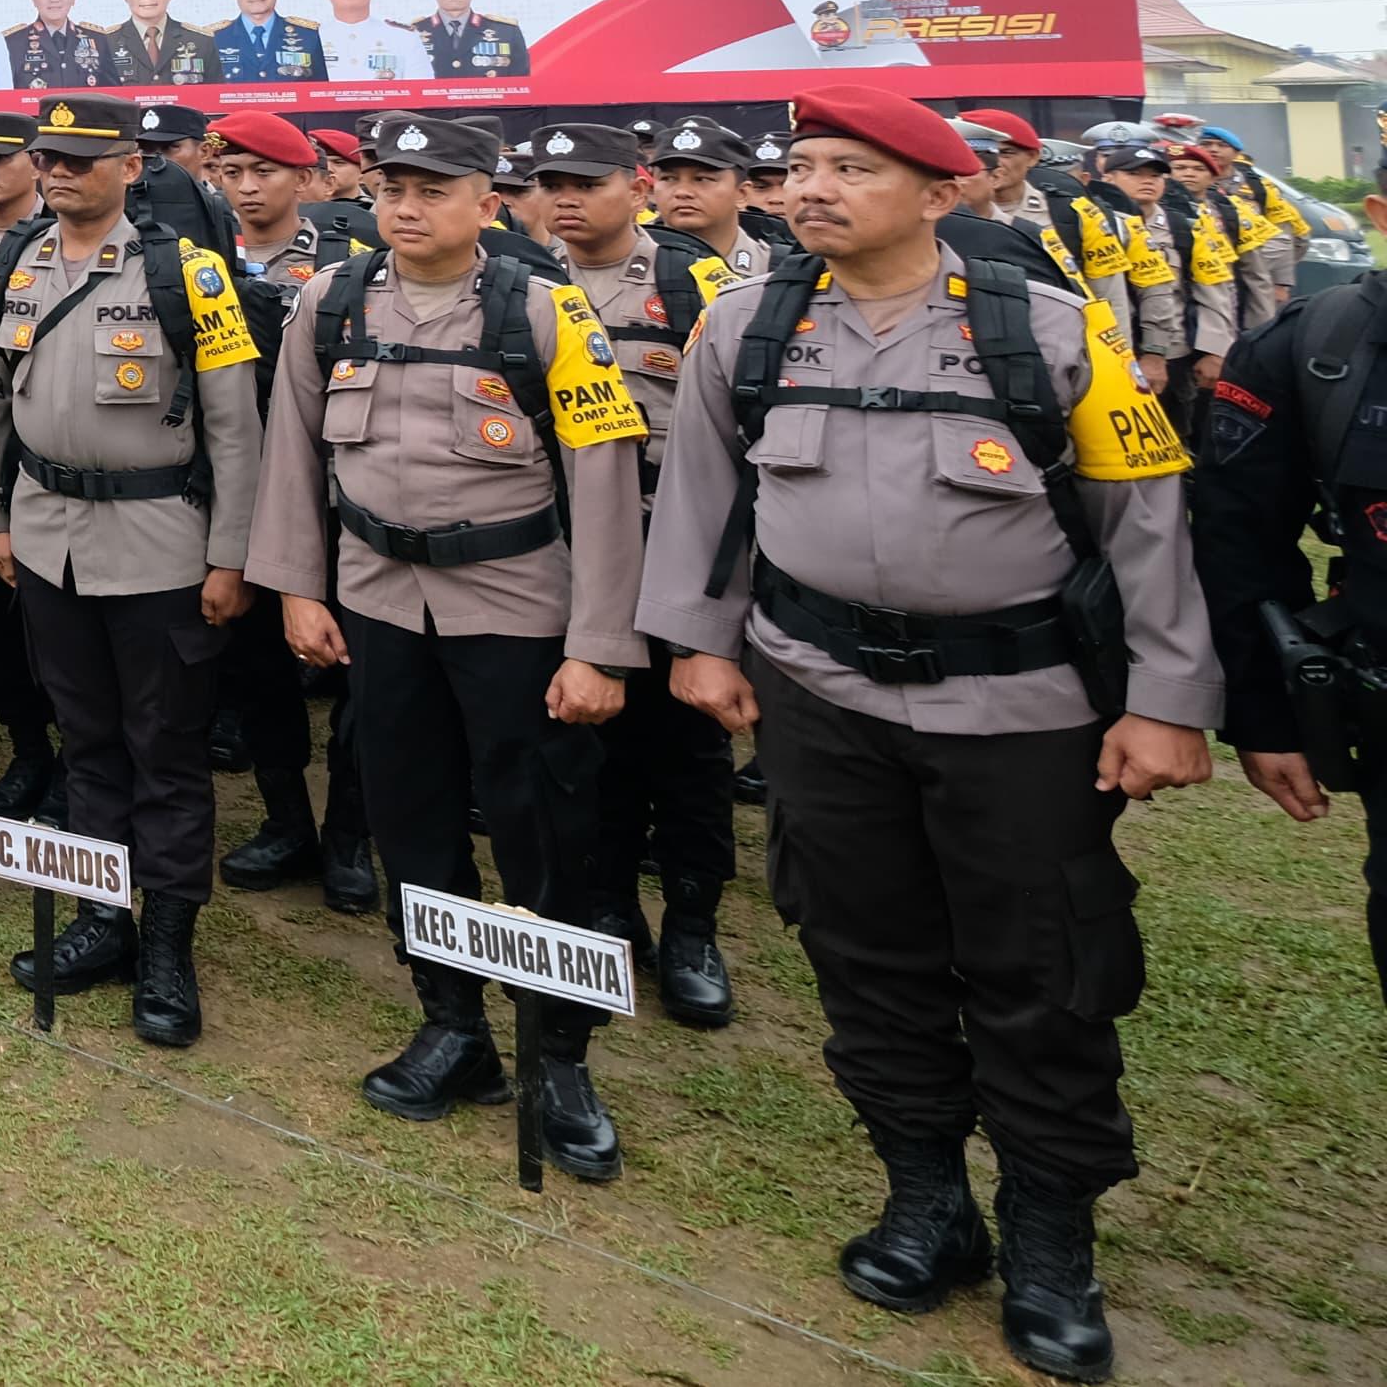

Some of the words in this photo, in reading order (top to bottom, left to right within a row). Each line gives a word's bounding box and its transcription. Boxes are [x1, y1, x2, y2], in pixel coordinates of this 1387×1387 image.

[863, 13, 1057, 44] PRESISI
[1087, 244, 1117, 261] PAM
[4, 299, 38, 317] RDI
[193, 310, 225, 337] AM
[197, 335, 216, 349] MP
[220, 328, 238, 341] LK
[205, 341, 242, 358] POLRES
[785, 346, 823, 364] OK
[555, 381, 617, 412] PAM
[572, 407, 609, 423] OMP
[613, 403, 634, 415] LK
[594, 418, 639, 433] POLRES
[1109, 401, 1179, 452] PAM
[1126, 451, 1148, 468] OPS
[26, 835, 121, 893] KANDIS
[412, 902, 464, 953] KEC.
[467, 918, 553, 978] BUNGA
[557, 941, 623, 997] RAYA
